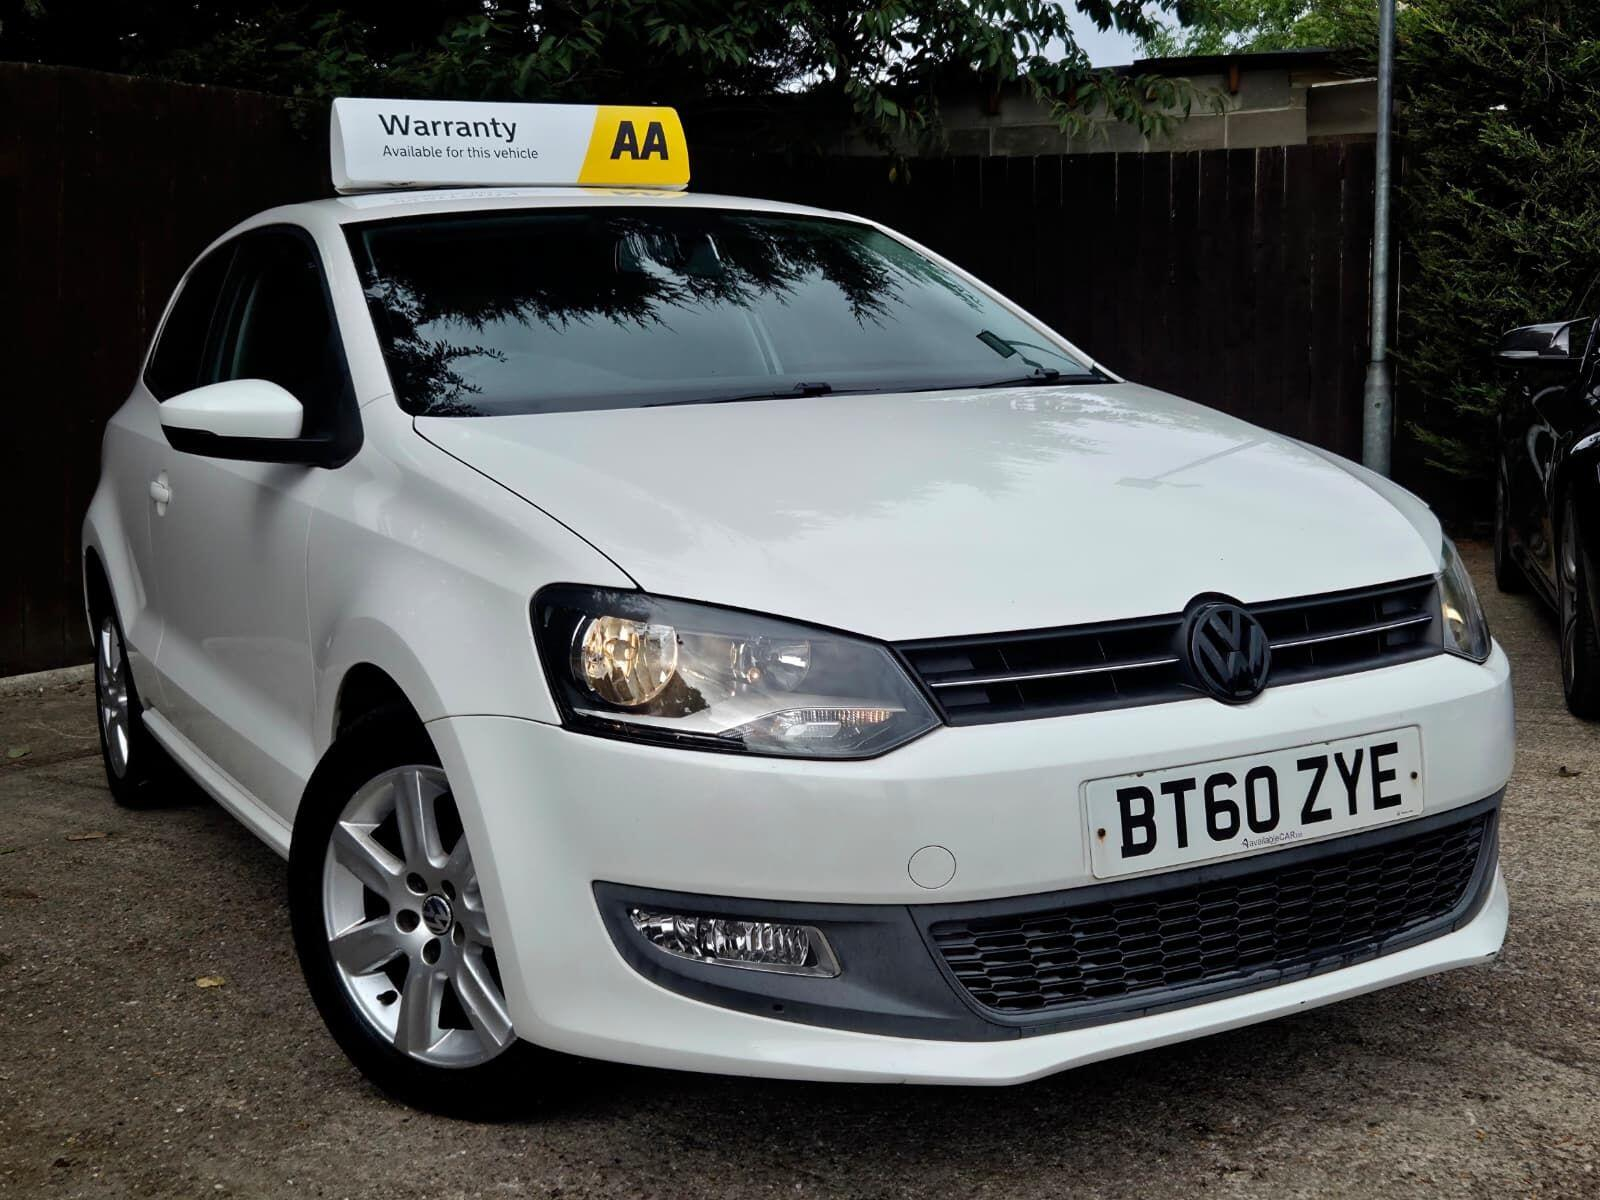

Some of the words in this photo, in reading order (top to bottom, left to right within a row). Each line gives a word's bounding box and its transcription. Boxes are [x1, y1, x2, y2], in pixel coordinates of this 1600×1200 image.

[378, 114, 517, 143] Warranty
[610, 120, 669, 161] AA
[382, 145, 443, 159] Available
[446, 146, 464, 159] for
[467, 147, 491, 159] this
[493, 147, 539, 160] vehicle
[1116, 765, 1280, 858] BT60
[1297, 742, 1402, 825] ZYE
